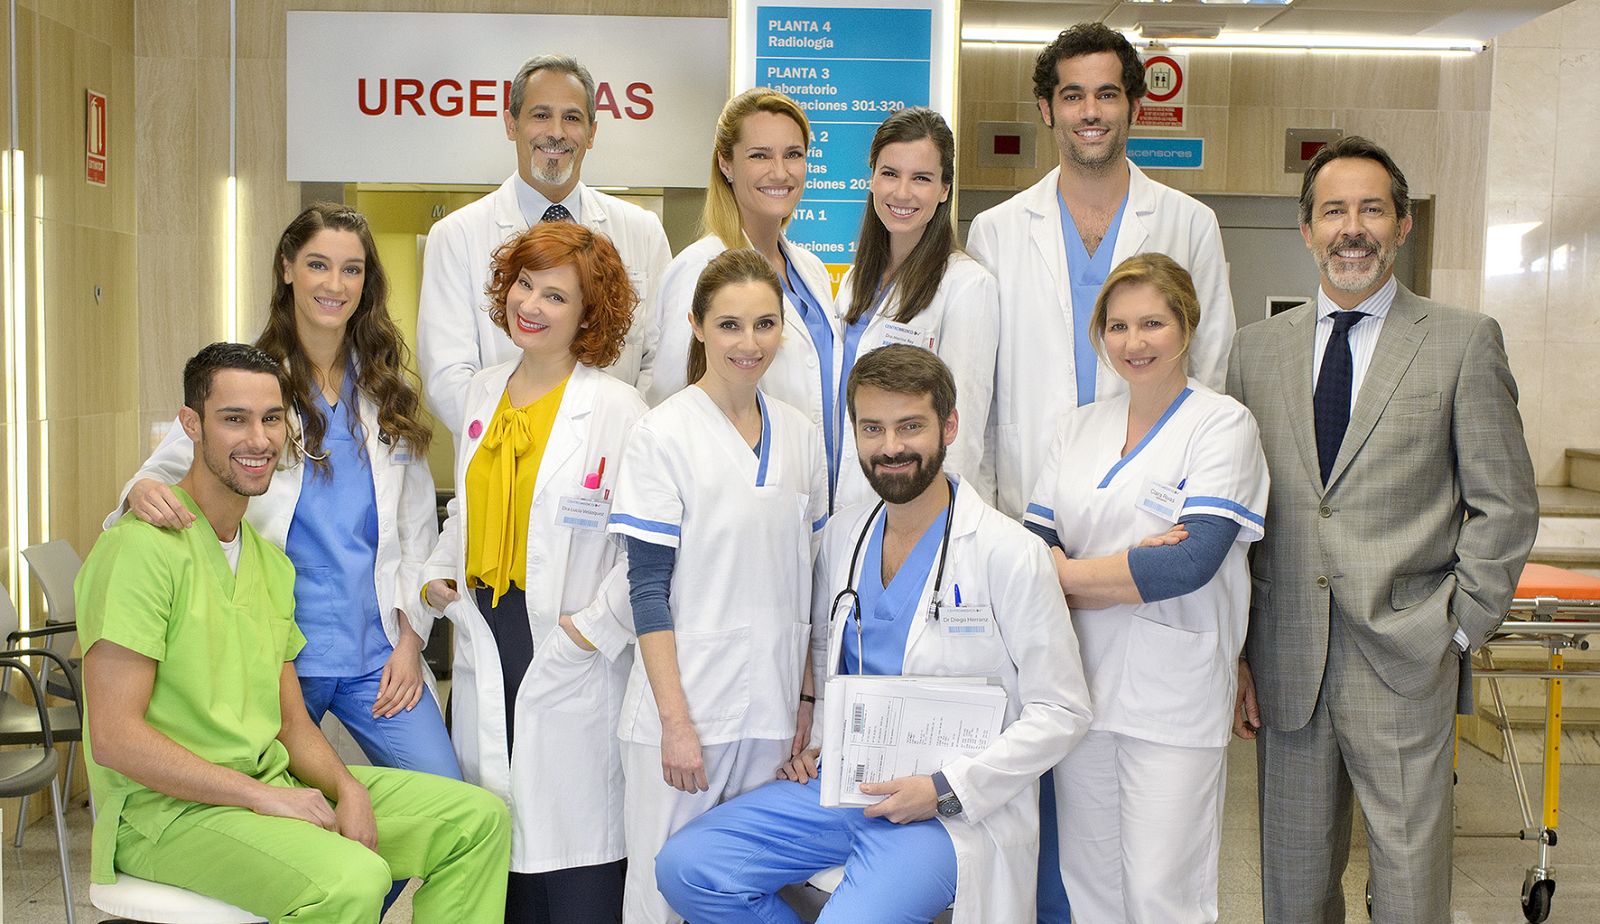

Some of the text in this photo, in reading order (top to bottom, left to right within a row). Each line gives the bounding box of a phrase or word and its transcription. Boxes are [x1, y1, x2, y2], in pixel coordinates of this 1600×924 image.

[768, 20, 832, 32] PLANTA 4
[768, 36, 834, 50] Radiología
[767, 67, 830, 79] PLANTA 3
[357, 78, 655, 120] URGEAS
[851, 100, 905, 112] 301-320
[820, 131, 829, 143] 2
[1127, 149, 1193, 158] scensores
[818, 210, 828, 221] 1
